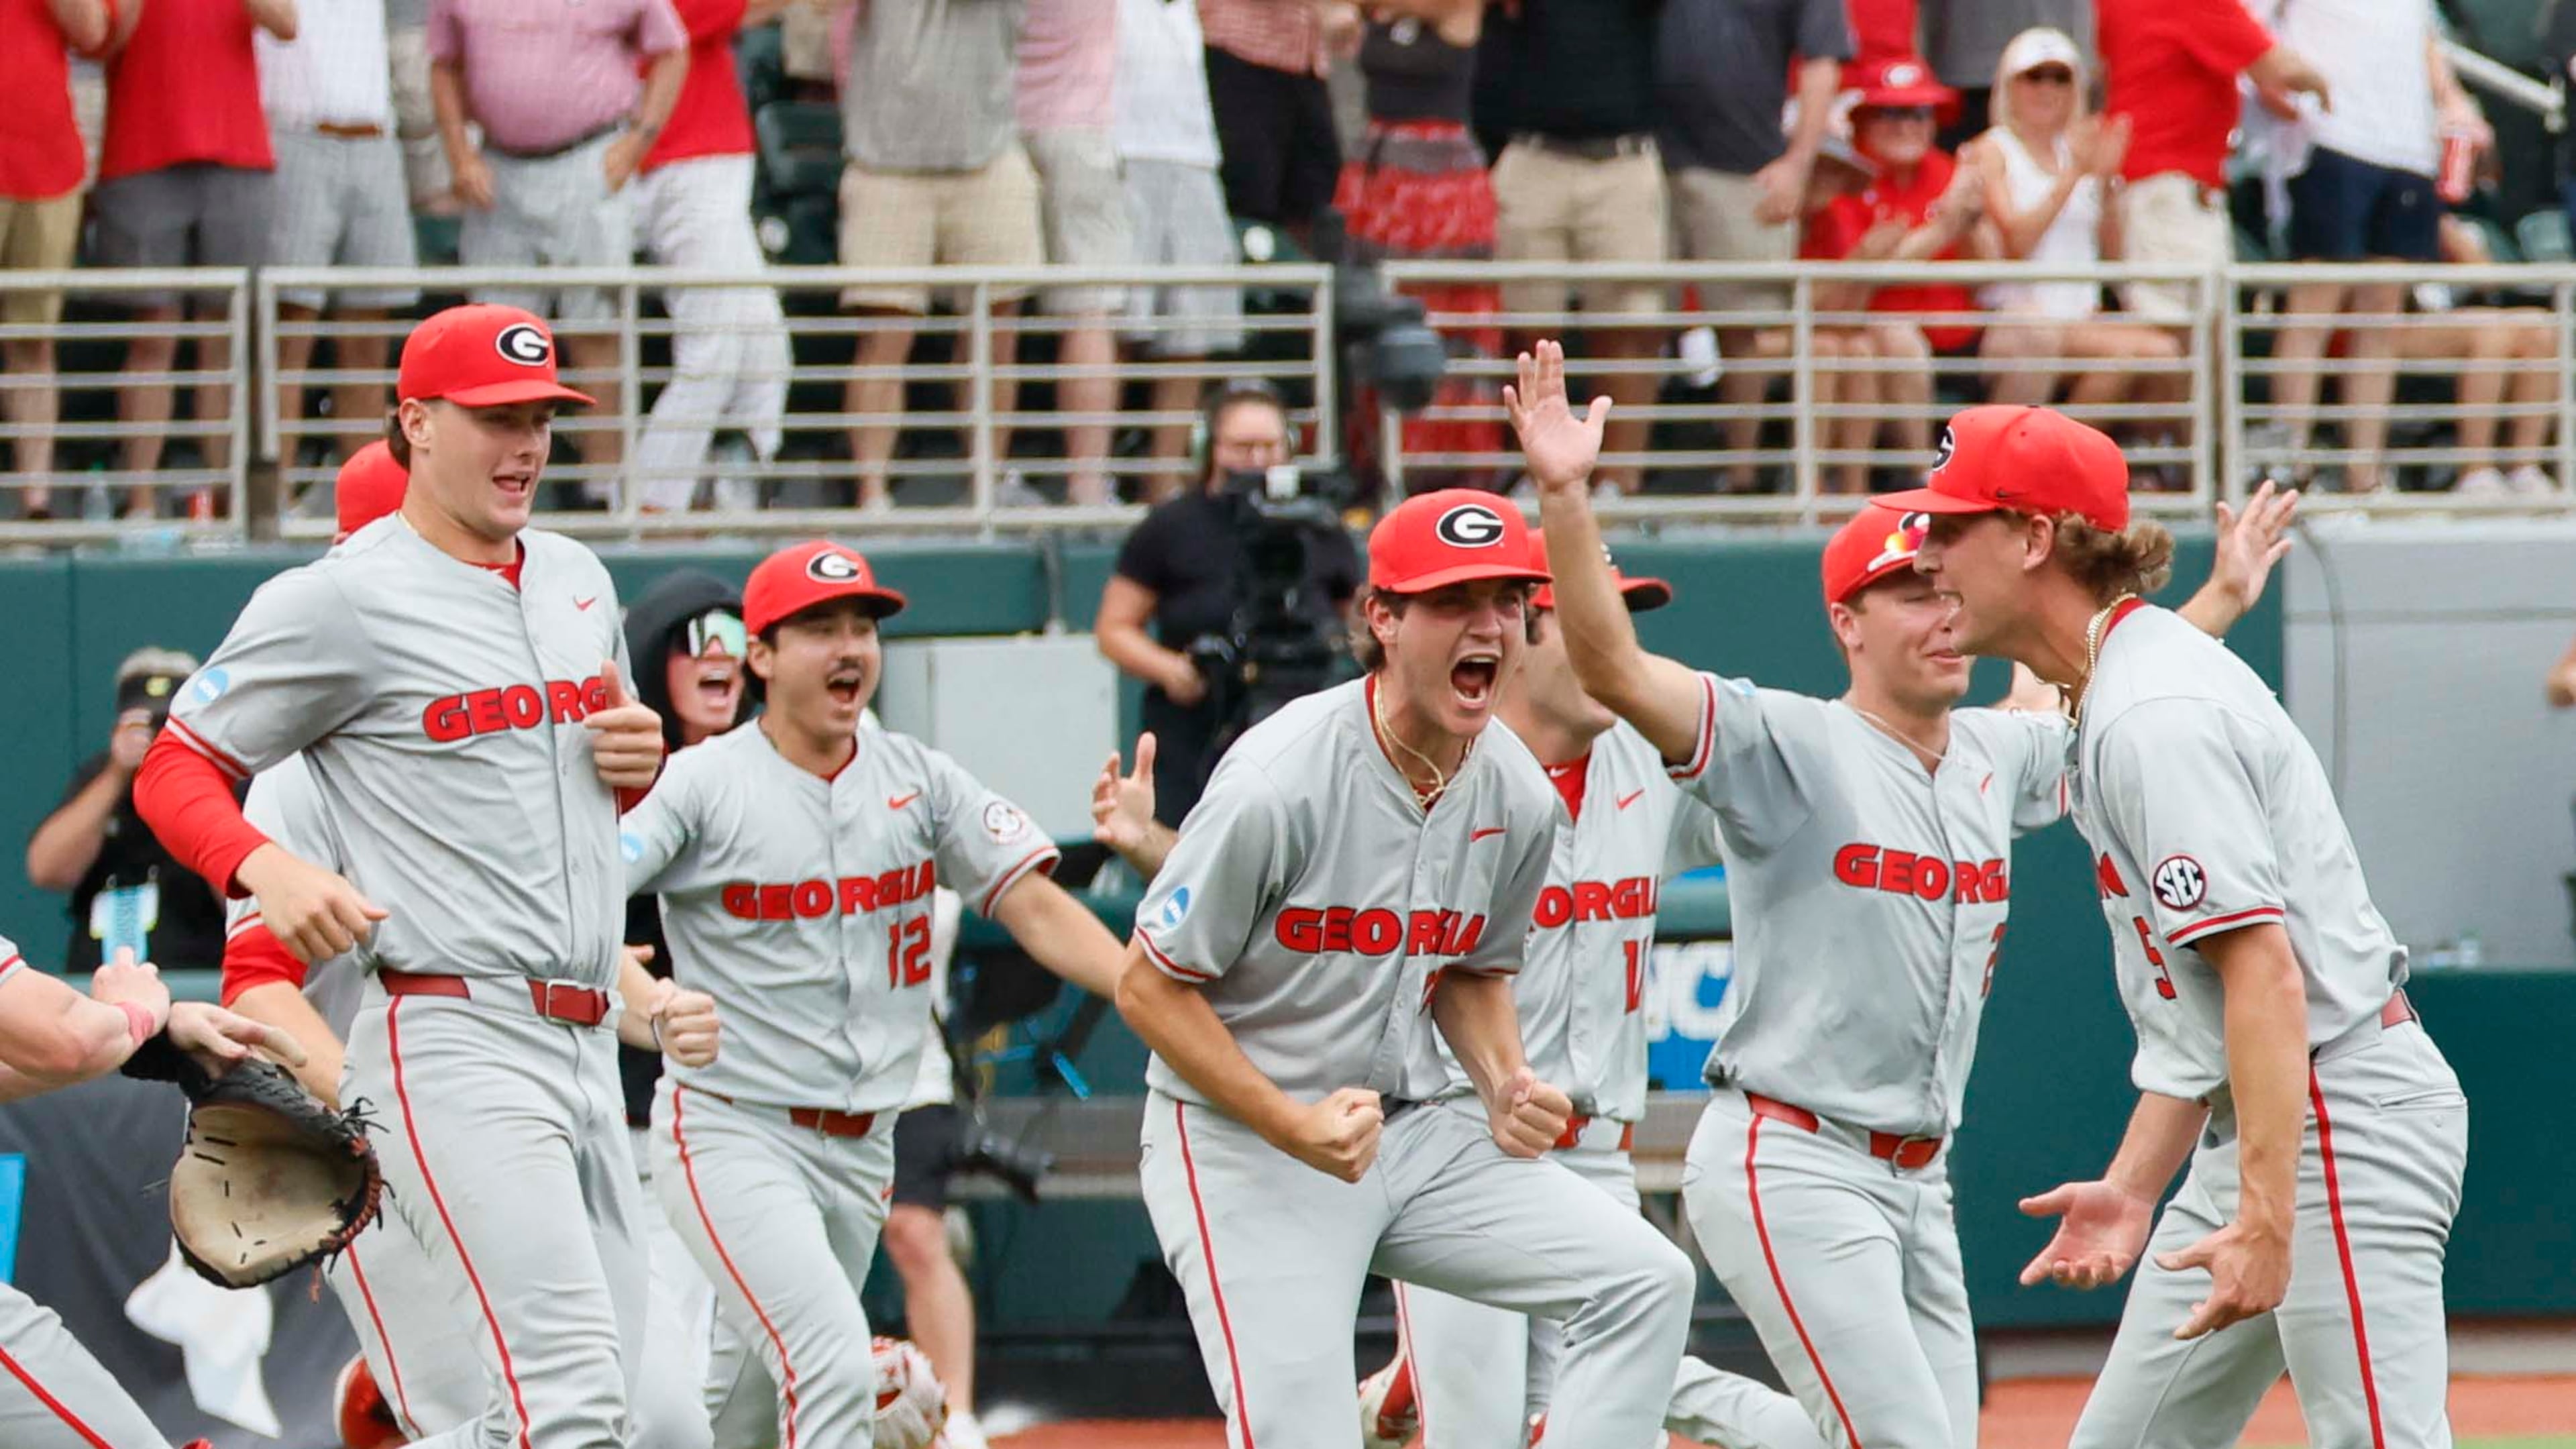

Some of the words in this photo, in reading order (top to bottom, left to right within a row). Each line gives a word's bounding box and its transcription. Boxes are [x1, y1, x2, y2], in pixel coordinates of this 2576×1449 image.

[1440, 506, 1504, 545] G
[423, 676, 608, 743] GEORG
[1531, 875, 1658, 928] ORGI
[1833, 843, 2010, 904] GEORG
[2155, 857, 2203, 907] SEC
[888, 913, 931, 990] 12
[1623, 937, 1648, 1015] 1
